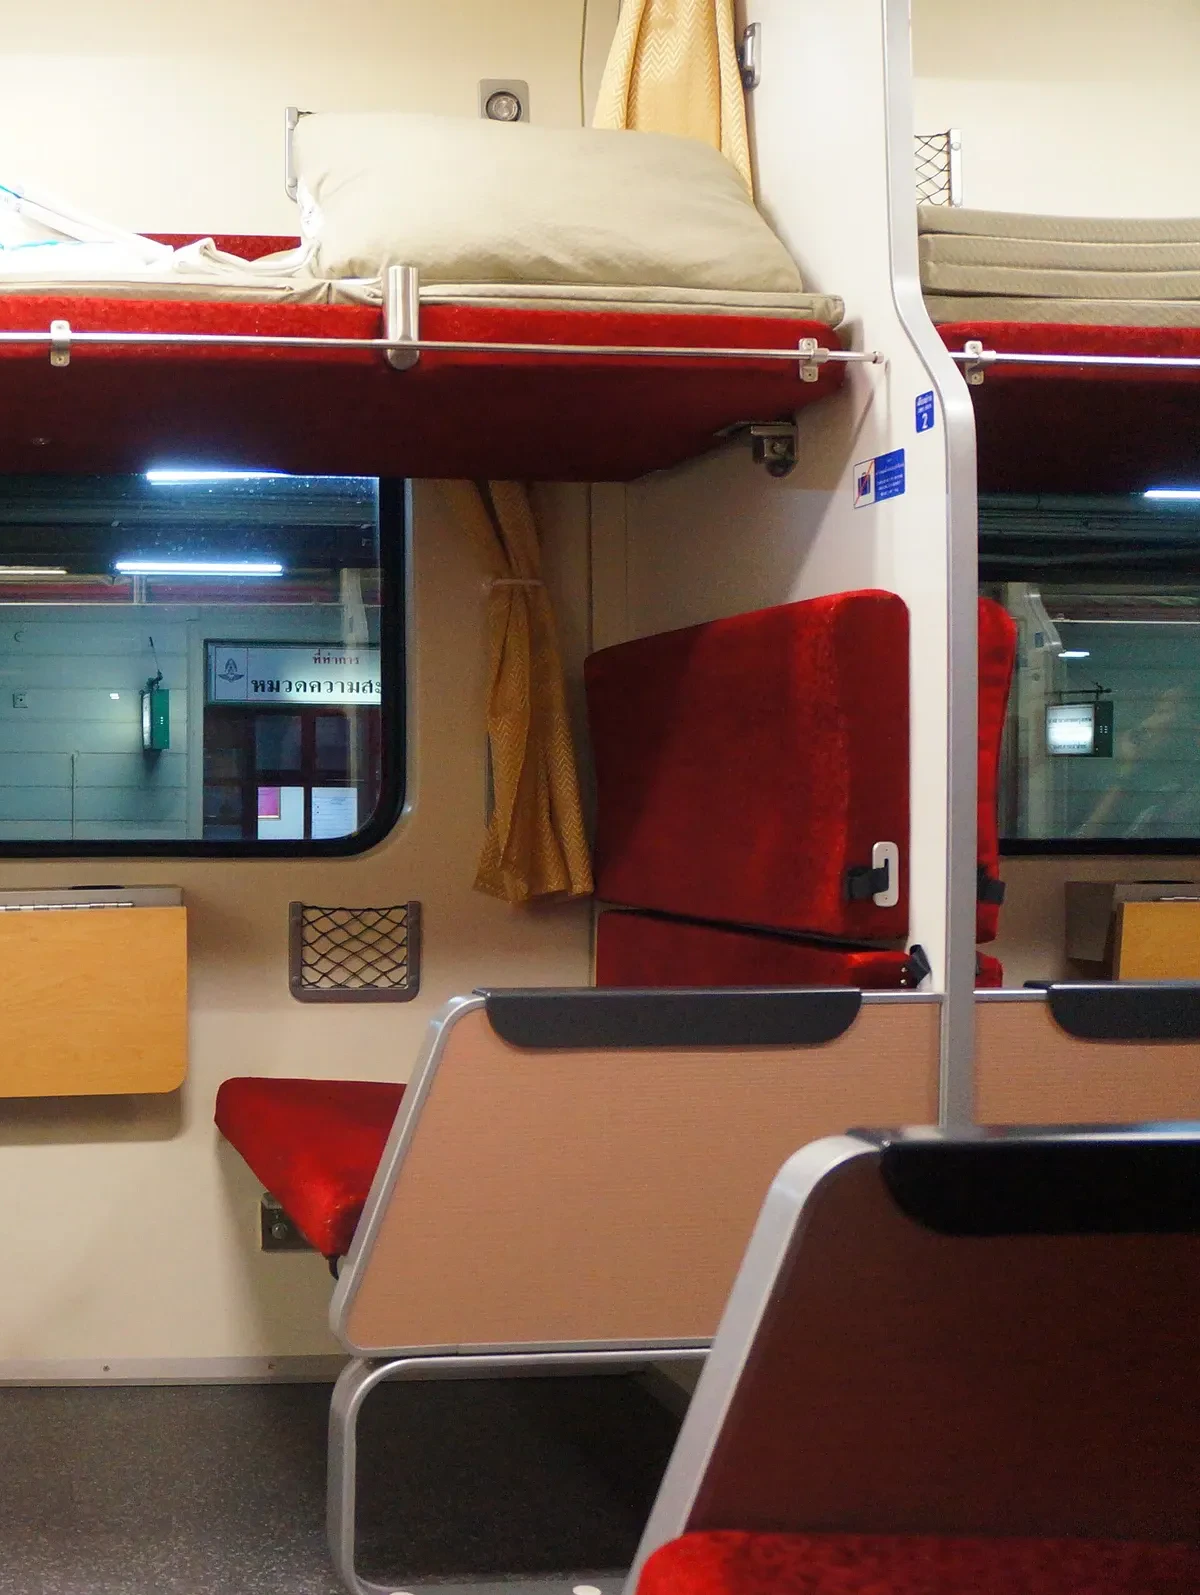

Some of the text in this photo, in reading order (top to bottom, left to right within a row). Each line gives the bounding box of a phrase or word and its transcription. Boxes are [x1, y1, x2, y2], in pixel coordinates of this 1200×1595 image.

[921, 412, 928, 429] 2
[312, 649, 360, 665] ที่ทำการ
